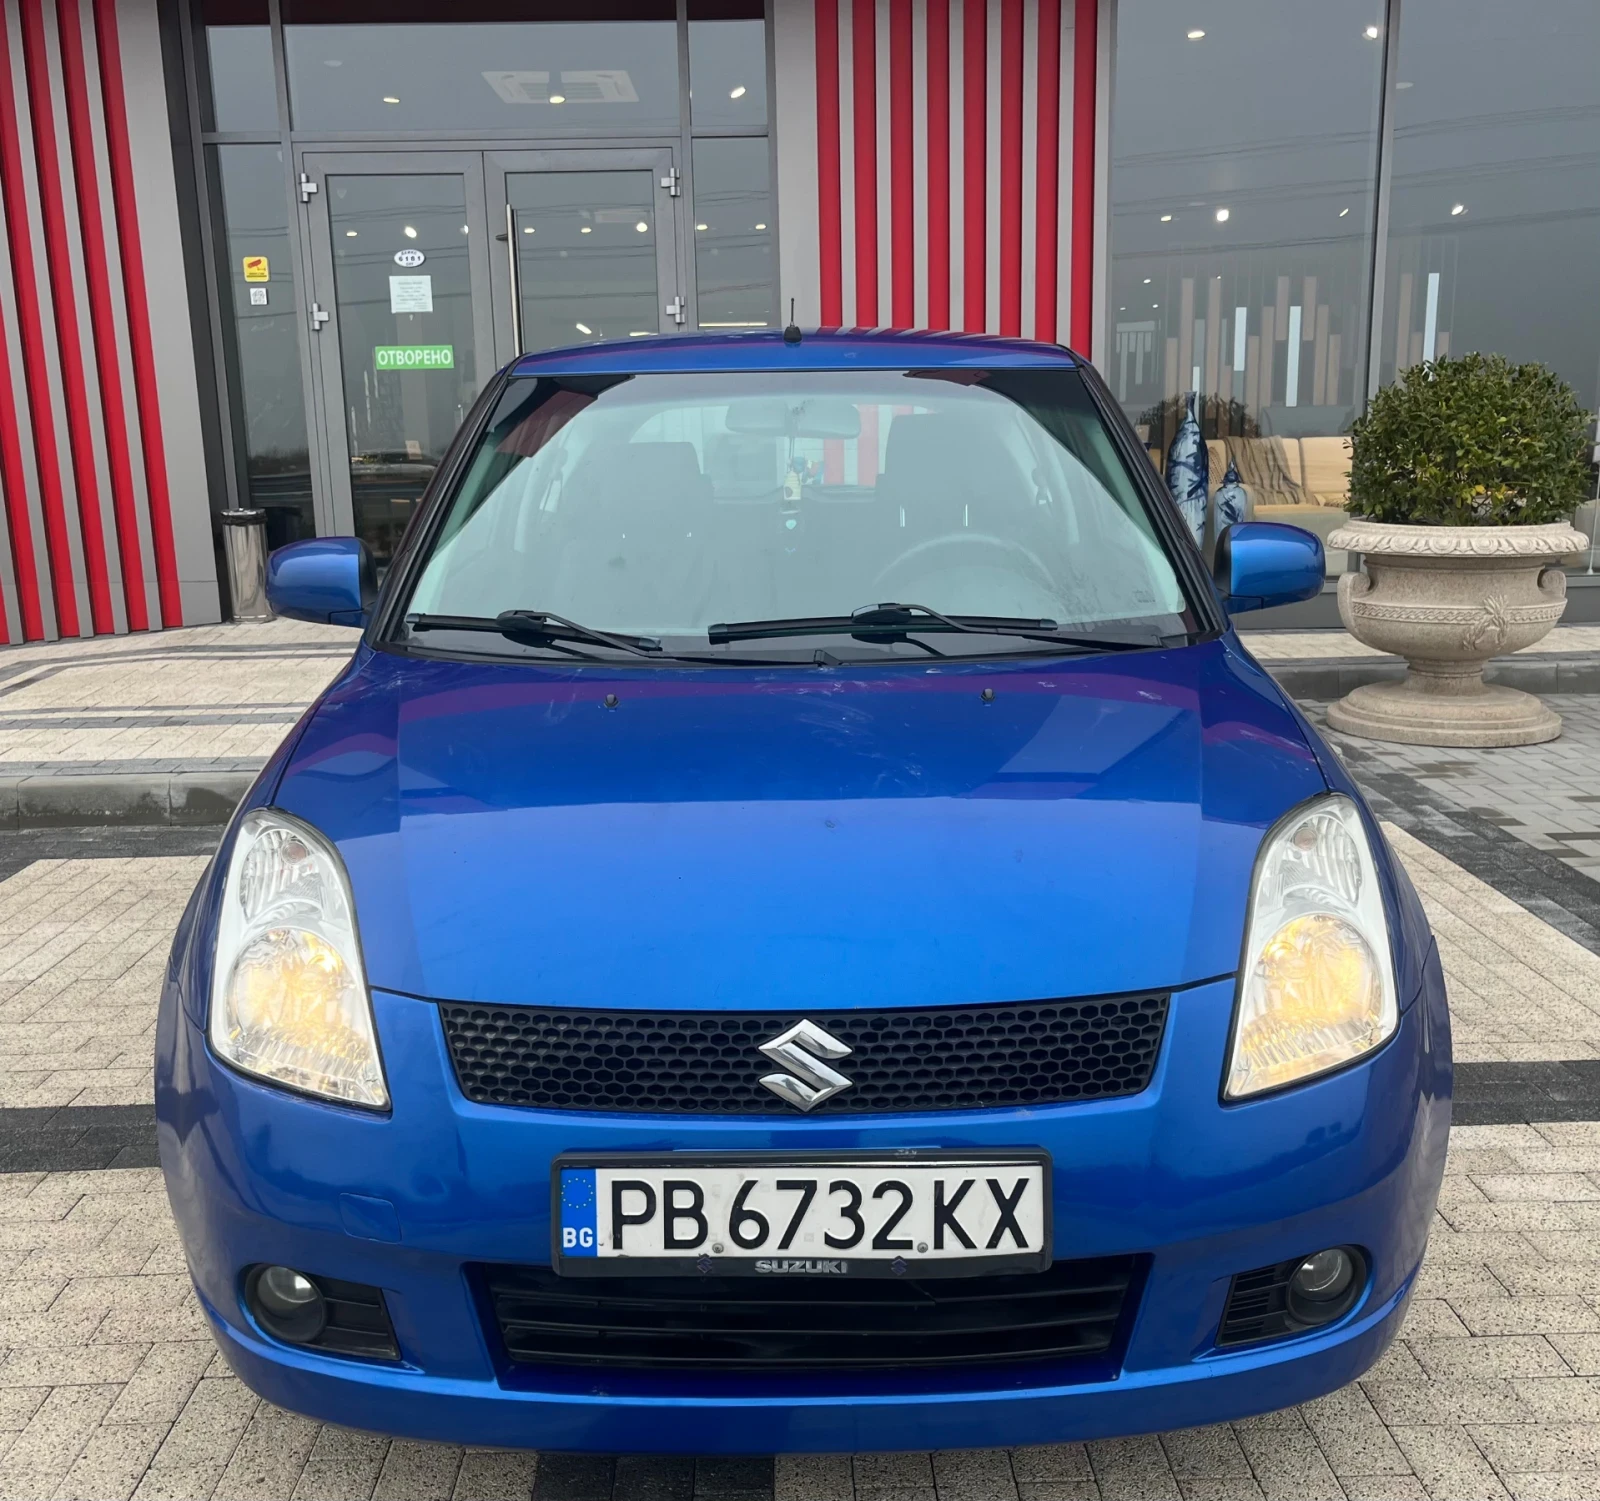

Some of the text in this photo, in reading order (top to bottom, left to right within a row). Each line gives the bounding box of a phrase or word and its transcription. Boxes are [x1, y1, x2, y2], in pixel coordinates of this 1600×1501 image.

[377, 349, 452, 365] ОТВОРЕНО
[611, 1177, 1030, 1250] PB 6732 KX
[562, 1226, 594, 1249] BG
[754, 1259, 848, 1274] SUZUKI
